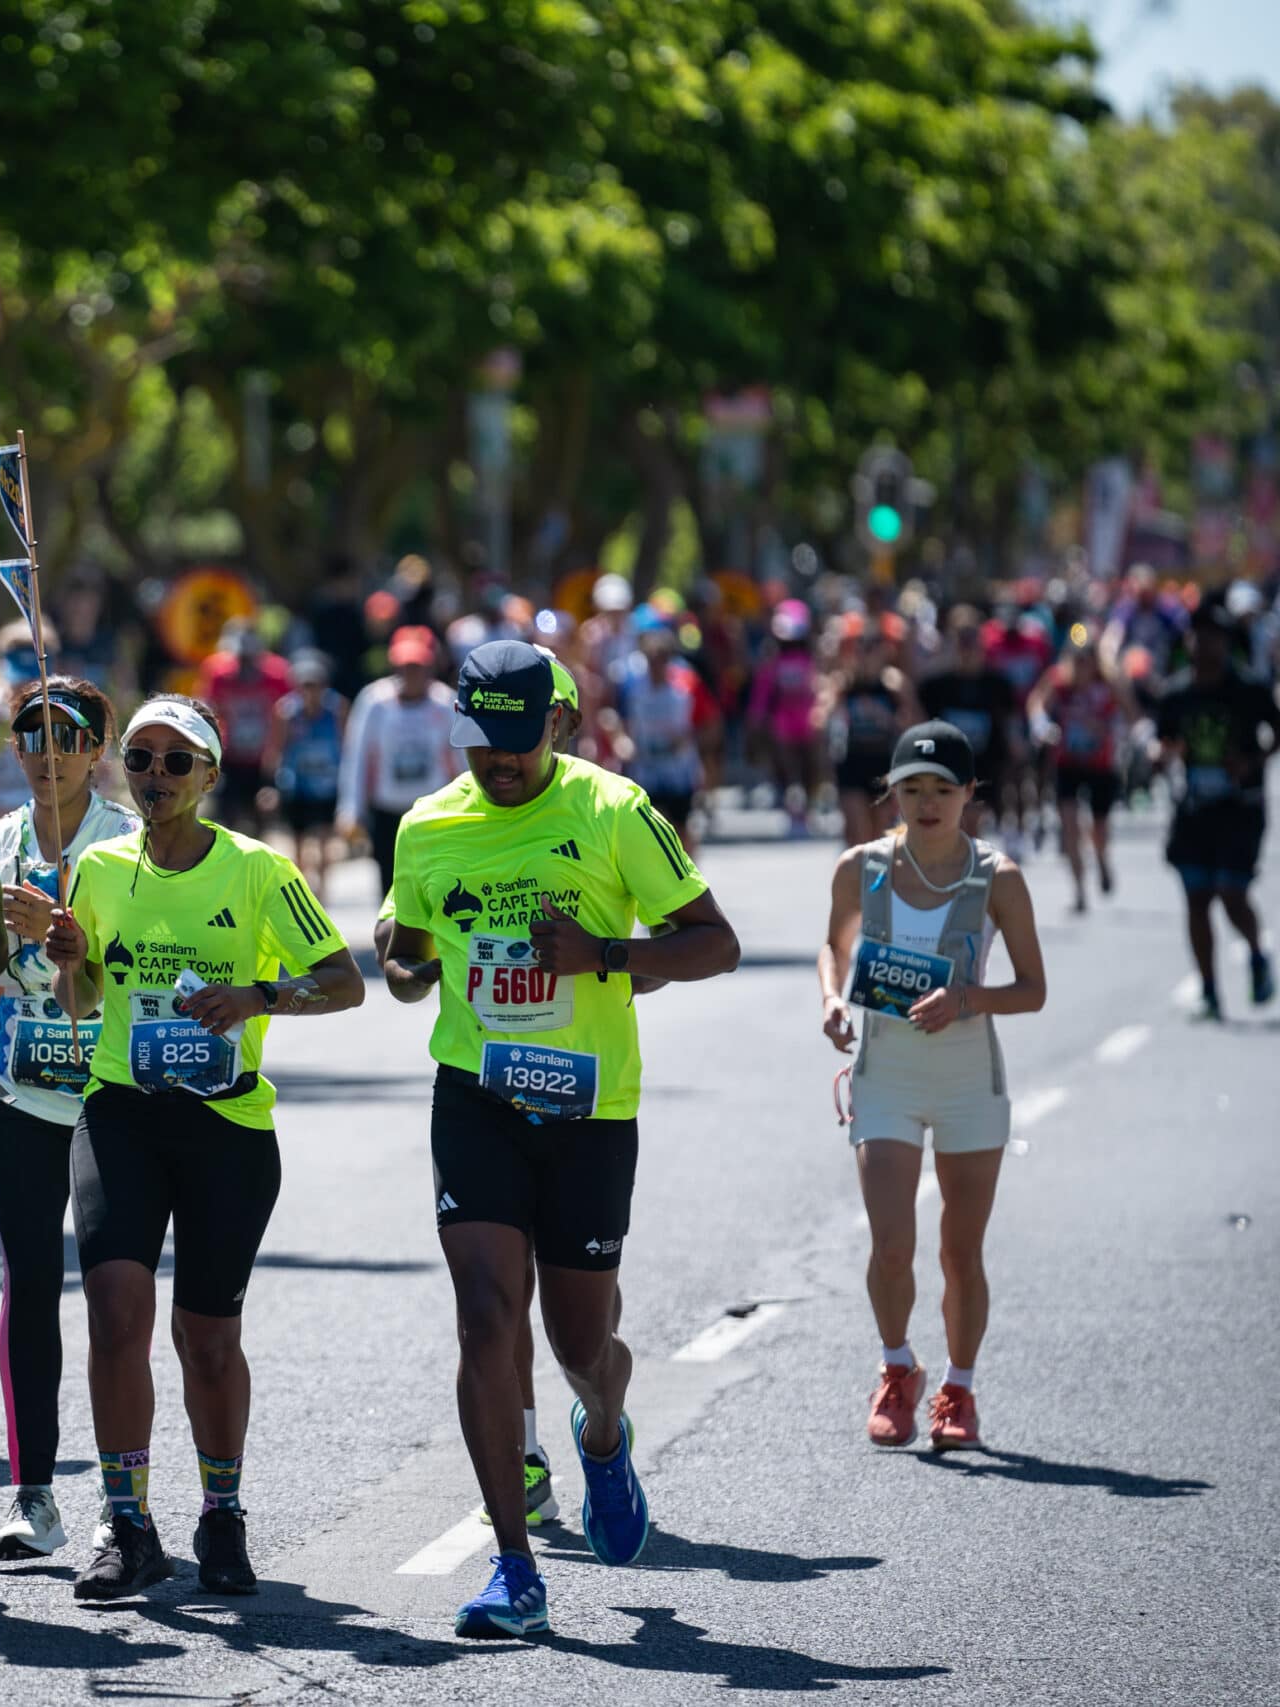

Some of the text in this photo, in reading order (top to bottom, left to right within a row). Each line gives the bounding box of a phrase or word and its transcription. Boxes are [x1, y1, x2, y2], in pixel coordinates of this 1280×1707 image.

[496, 877, 538, 893] Sanlam
[488, 890, 581, 912] CAPE TOWN
[489, 905, 579, 928] MARATN
[150, 942, 197, 956] Sanlam
[478, 951, 493, 960] 2024
[138, 957, 234, 974] CAPE TOWN
[889, 950, 932, 969] Sanlam
[468, 966, 557, 1005] P 5607
[867, 960, 932, 992] 12690
[140, 997, 159, 1007] WPA
[28, 1043, 97, 1064] 10593
[138, 1041, 151, 1070] PACER
[162, 1043, 210, 1063] 825
[525, 1051, 573, 1069] Sanlam
[503, 1066, 577, 1095] 13922
[122, 1452, 145, 1460] BACK
